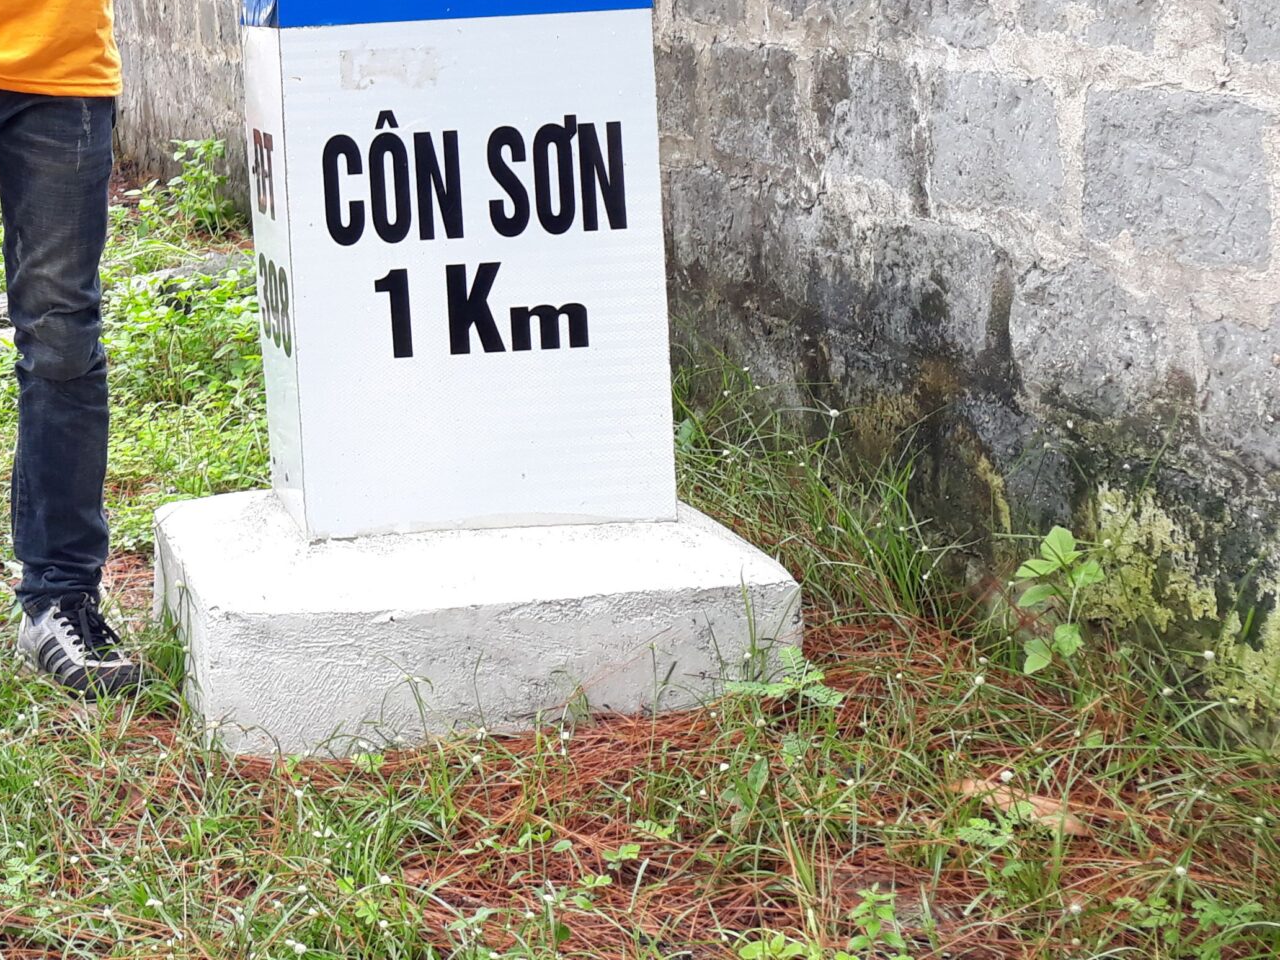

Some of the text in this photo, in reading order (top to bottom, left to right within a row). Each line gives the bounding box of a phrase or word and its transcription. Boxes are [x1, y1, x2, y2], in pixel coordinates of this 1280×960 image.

[252, 127, 276, 221] ĐT
[322, 109, 628, 247] CÔN SƠN
[258, 252, 292, 358] 398
[374, 261, 590, 359] 1 Km
